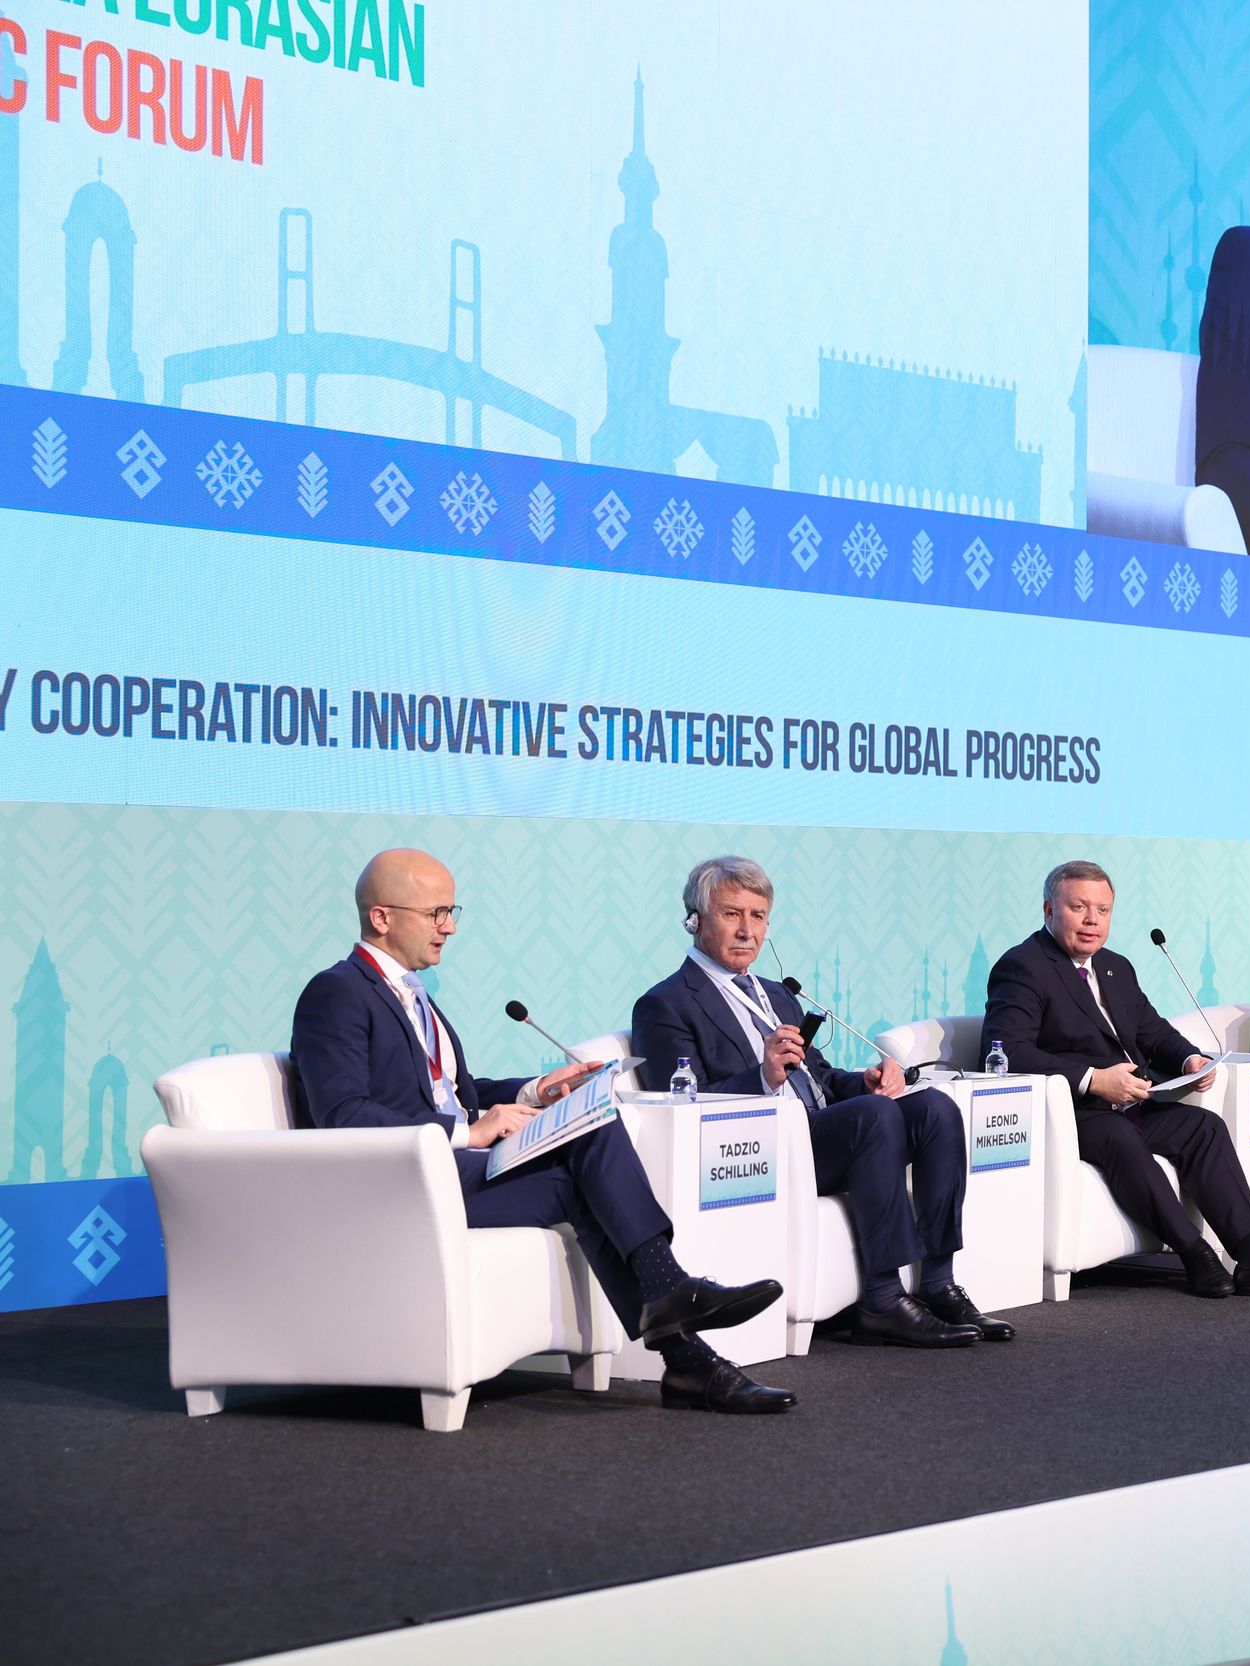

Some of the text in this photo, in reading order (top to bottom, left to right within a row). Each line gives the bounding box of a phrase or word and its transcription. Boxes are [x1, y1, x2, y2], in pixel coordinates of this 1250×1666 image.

[135, 0, 425, 88] RASIAN
[45, 29, 264, 166] FORUM
[30, 669, 338, 748] COOPERATION:
[351, 690, 568, 759] INNOVATIVE
[578, 704, 774, 769] STRATEGIES
[783, 718, 840, 772] FOR
[848, 722, 958, 778] GLOBAL
[965, 729, 1101, 785] PROGRESS
[986, 1113, 1019, 1128] LEONID
[719, 1141, 760, 1158] TADZIO
[976, 1131, 1027, 1149] MIKHELSON
[710, 1161, 768, 1181] SCHILLING
